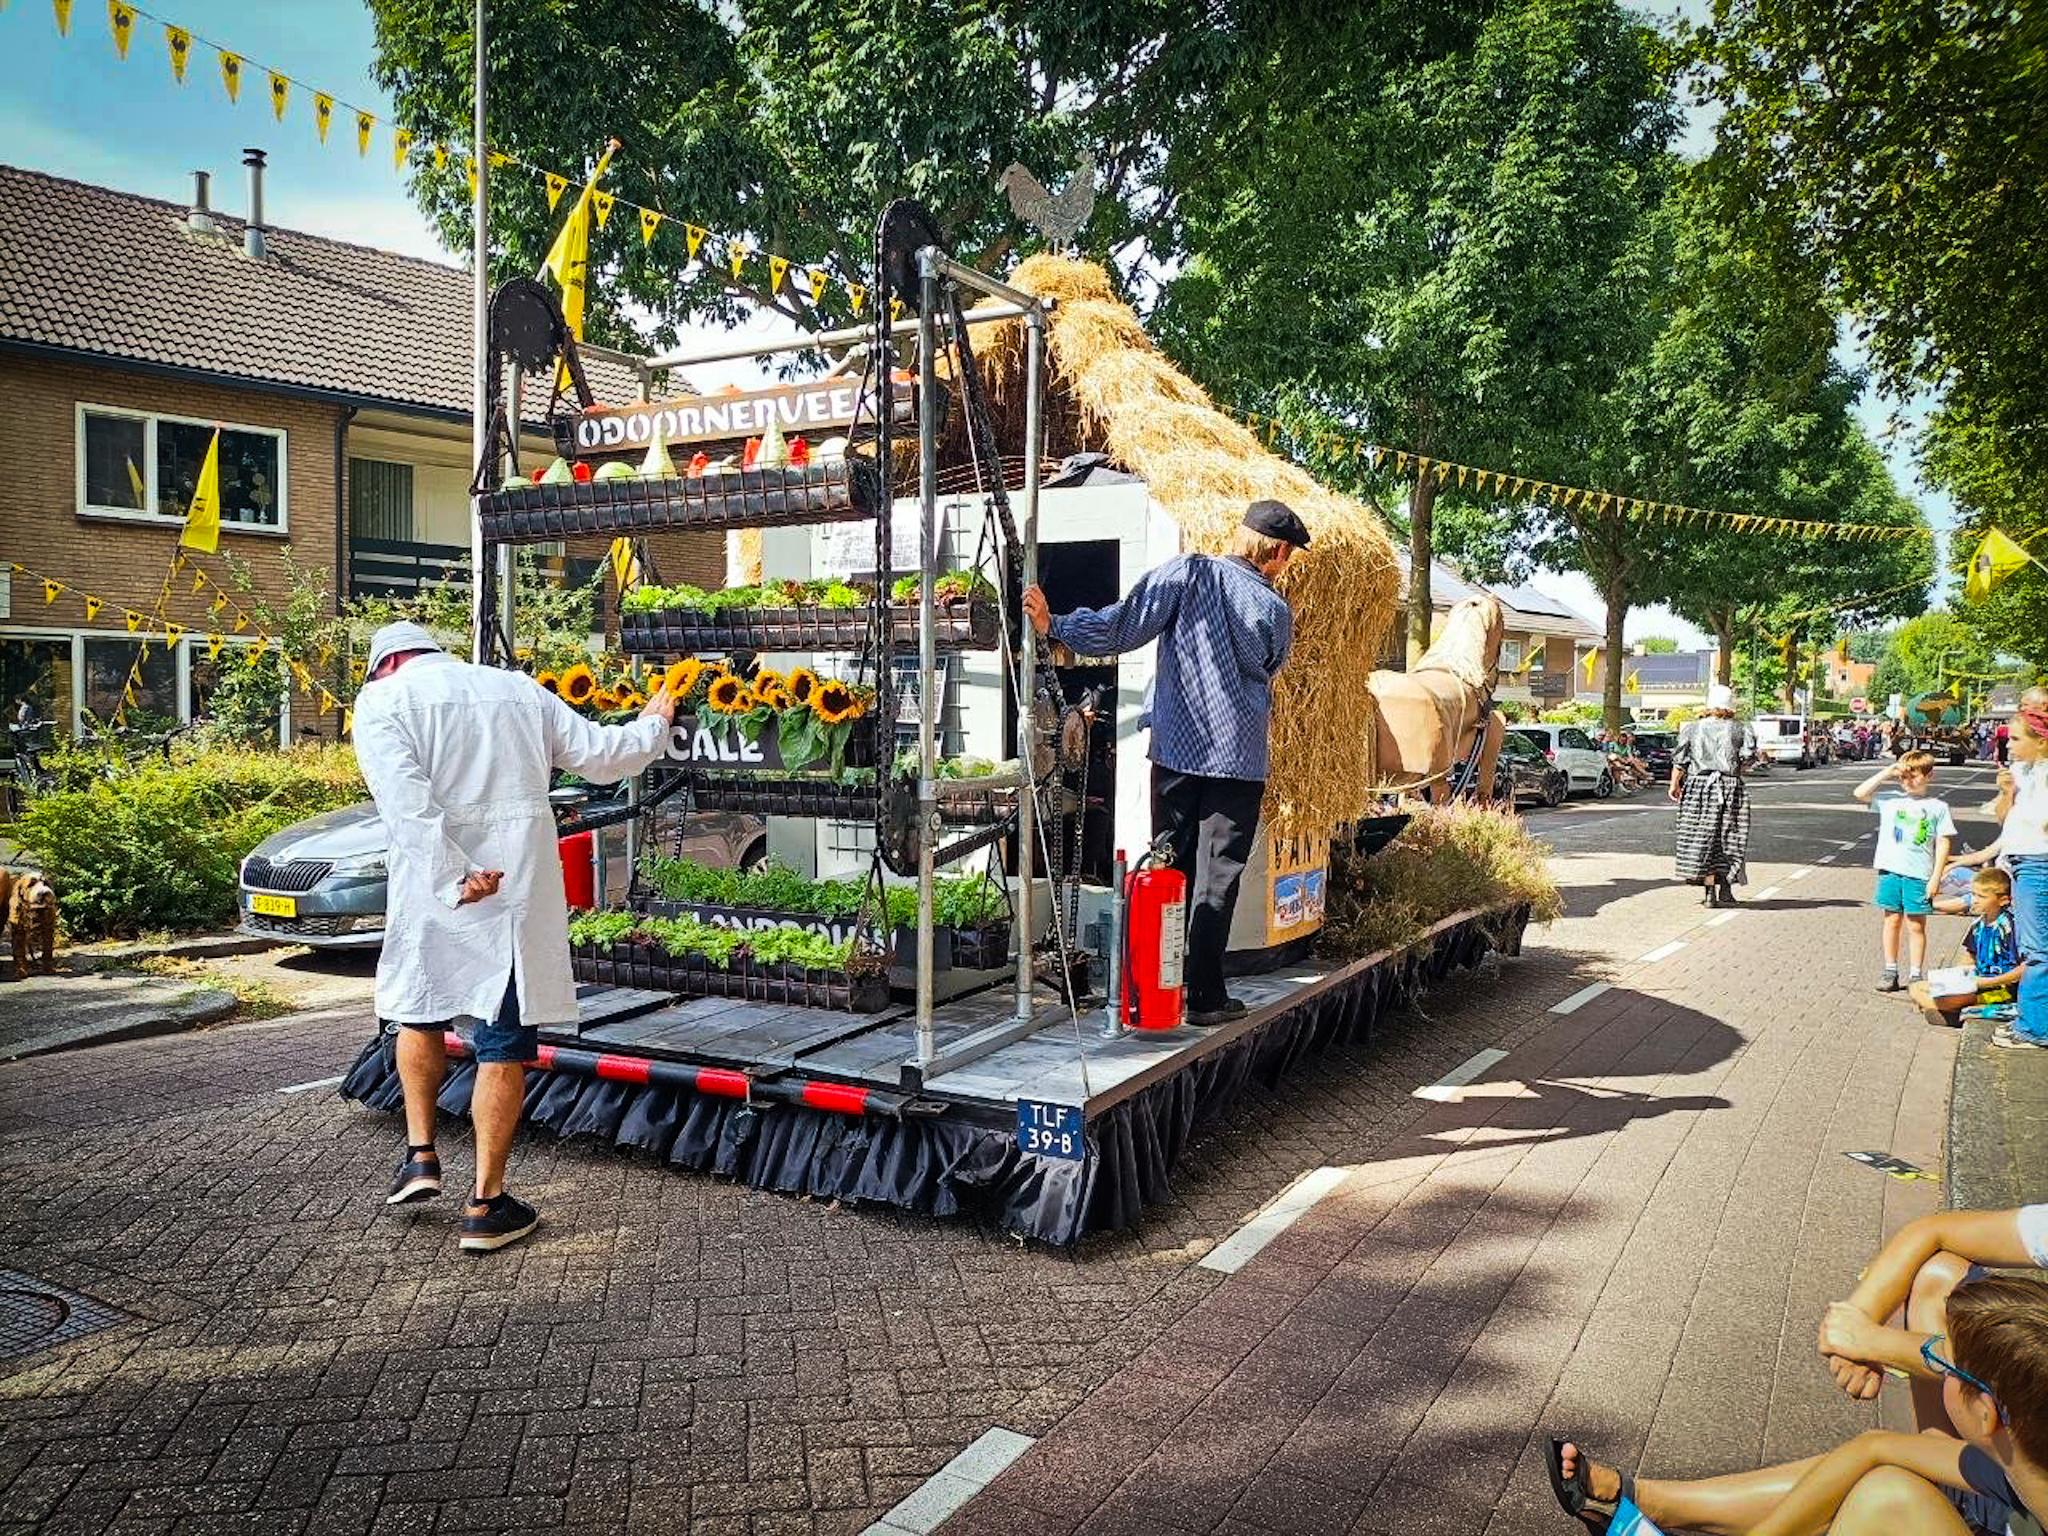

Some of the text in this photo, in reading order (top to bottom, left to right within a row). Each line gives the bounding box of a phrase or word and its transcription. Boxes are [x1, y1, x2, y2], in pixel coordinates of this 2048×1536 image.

[657, 725, 765, 763] CALE
[1030, 1104, 1068, 1129] TLF
[1028, 1127, 1072, 1154] 39-B
